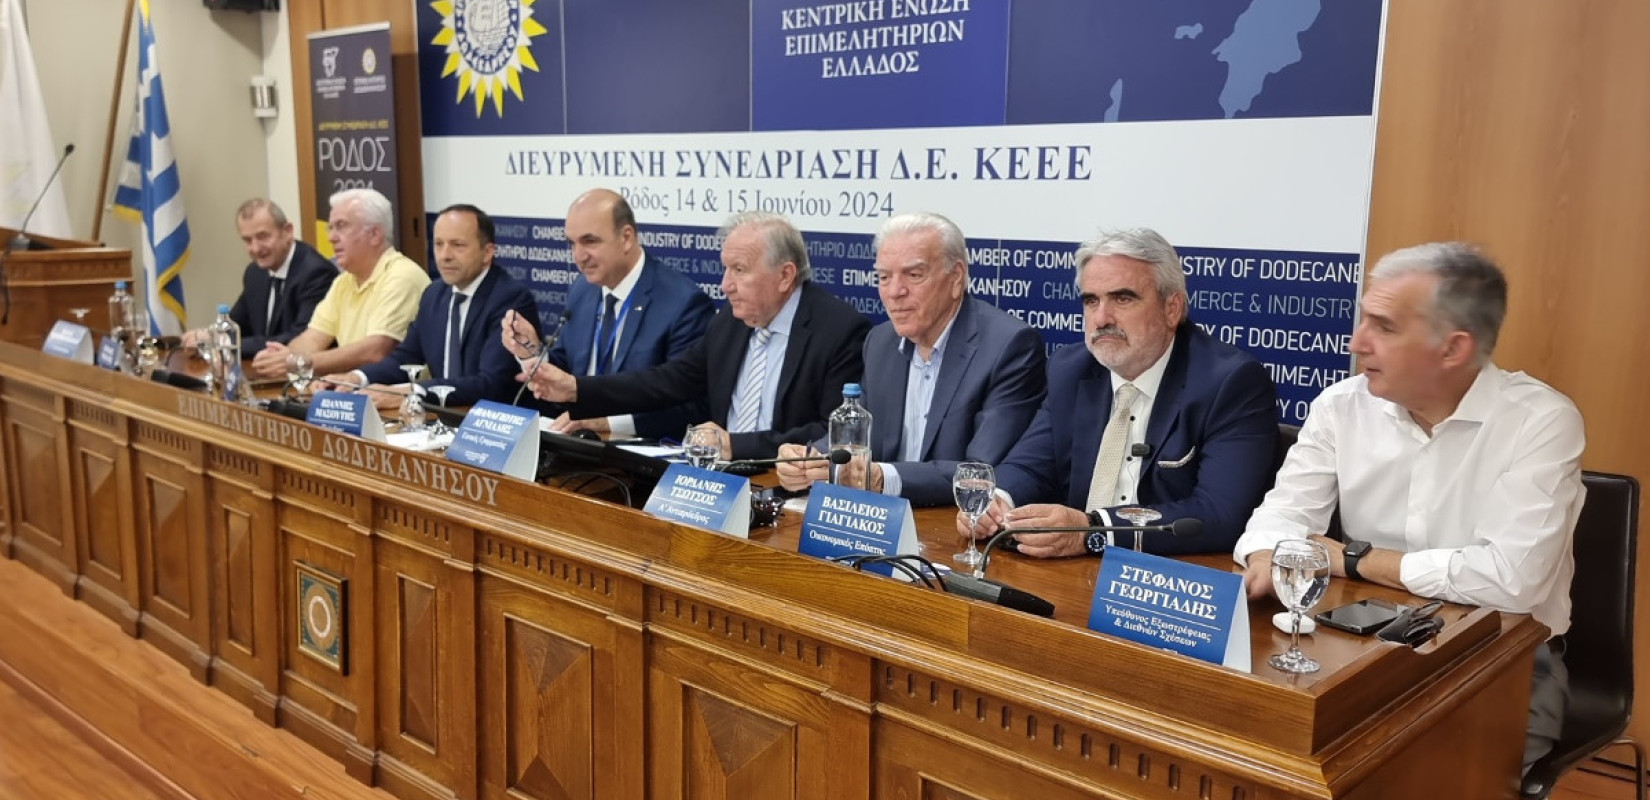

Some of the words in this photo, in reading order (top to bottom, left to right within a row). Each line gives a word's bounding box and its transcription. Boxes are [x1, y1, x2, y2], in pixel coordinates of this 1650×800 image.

[781, 4, 884, 30] ΚΕΝΤΡΙΚΗ
[890, 0, 970, 19] ΕΝΩΣΗ
[784, 19, 964, 56] ΕΠΙΜΕΛΗΤΗΡΙΩΝ
[822, 51, 919, 78] ΕΛΛΑΔΟΣ
[318, 136, 391, 172] ΡΟΔΟΣ
[505, 150, 664, 177] ΔΙΕΥΡΥΜΕΝΗ
[676, 148, 879, 179] ΣΥΝΕΔΡΙΑΣΗ
[890, 147, 958, 180] Δ.Ε.
[973, 145, 1092, 180] ΚΕΕΕ
[620, 187, 669, 216] Ρόδος
[678, 189, 696, 212] 14
[702, 190, 718, 213] &
[728, 191, 747, 213] 15
[755, 191, 831, 215] Ιουνίου
[839, 191, 894, 218] 2024
[532, 226, 567, 241] CHAMBE
[1013, 250, 1032, 267] OF
[1231, 258, 1255, 278] OF
[967, 277, 1032, 298] ΚΑΝΗΣΟΥ
[1187, 290, 1244, 312] MERCE
[1249, 293, 1262, 312] &
[1028, 310, 1085, 332] COMME
[1220, 325, 1244, 345] OF
[177, 392, 313, 452] ΕΠΙΜΕΛΗΤΗΡΙΟ
[322, 435, 500, 507] ΔΩΔΕΚΑΝΗΣΟΥ
[817, 510, 886, 536] ΓΙΑΓΙΑΚΟΣ
[822, 496, 889, 521] ΒΑΣΙΛΕΙΟΣ
[1119, 564, 1214, 600] ΣΤΕΦΑΝΟΣ
[1108, 580, 1218, 621] ΓΕΩΡΓΙΑΔΗΣ
[1113, 617, 1124, 628] &
[1123, 620, 1159, 638] Διεθνών
